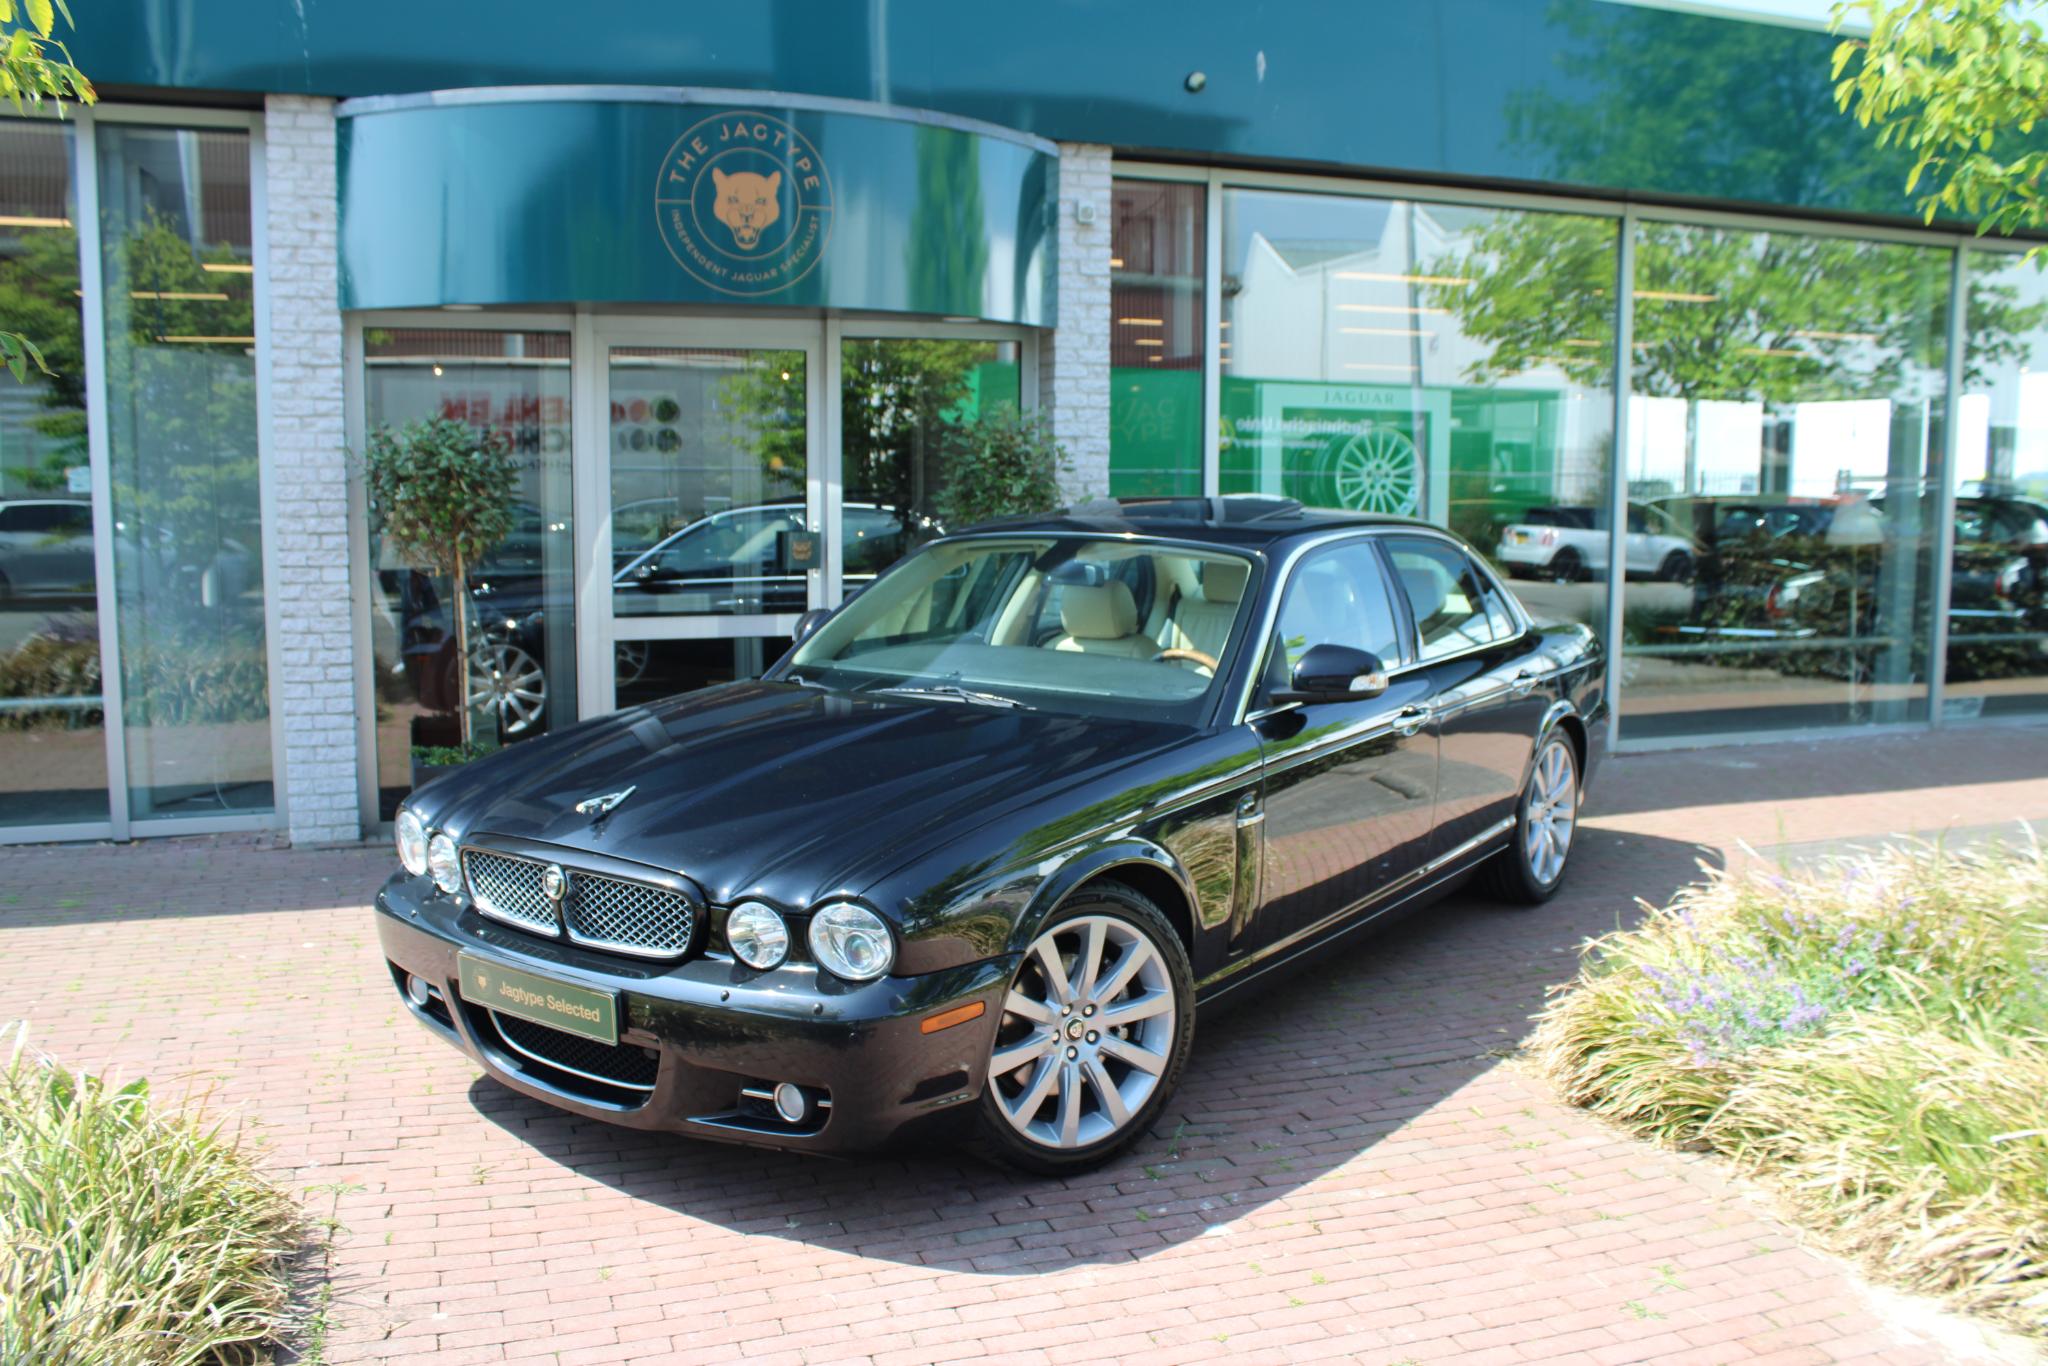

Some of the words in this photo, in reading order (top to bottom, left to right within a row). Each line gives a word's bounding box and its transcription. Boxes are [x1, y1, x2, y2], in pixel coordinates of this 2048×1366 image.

[669, 136, 708, 183] THE
[719, 121, 821, 191] JAGTYPE
[672, 209, 727, 277] INDEPENDENT
[731, 267, 778, 283] JAGUAR
[780, 215, 821, 272] SPECIALIST
[1323, 390, 1394, 405] JAGUAR
[499, 980, 545, 1007] Jagtype
[546, 994, 601, 1023] Selected
[1169, 1012, 1192, 1084] KUMHO
